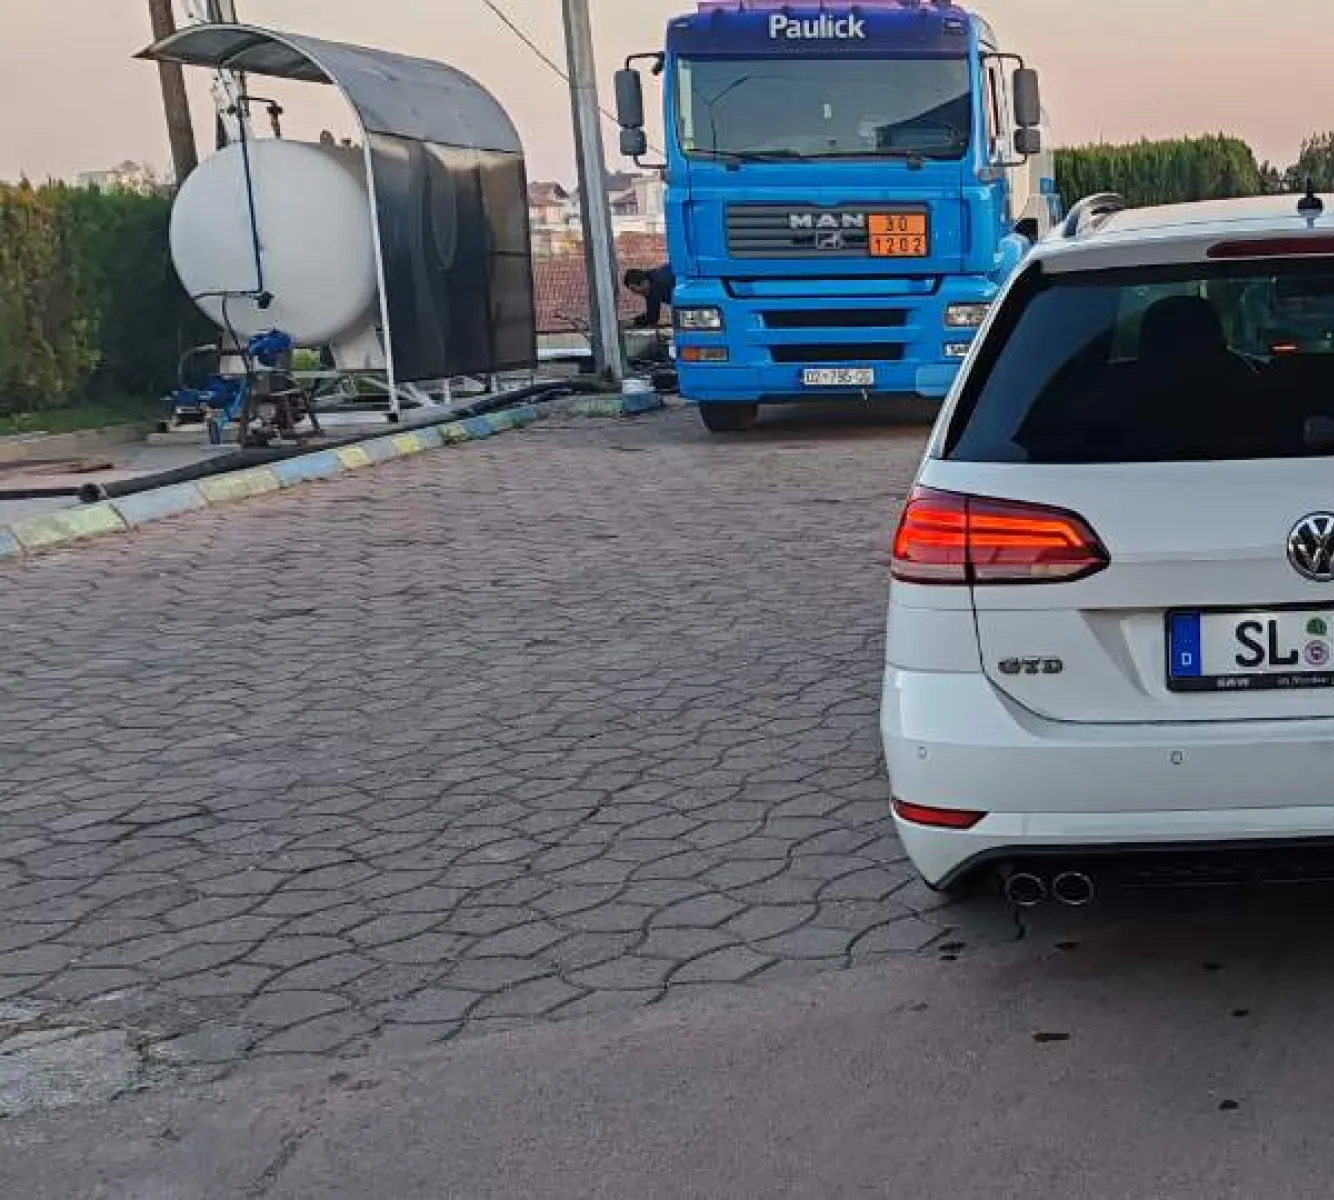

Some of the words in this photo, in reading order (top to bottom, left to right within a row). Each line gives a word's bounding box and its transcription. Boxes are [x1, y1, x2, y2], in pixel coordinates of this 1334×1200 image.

[769, 13, 866, 39] Paulick
[789, 213, 864, 228] MAN
[886, 215, 907, 232] 30
[875, 237, 922, 254] 1202
[1235, 619, 1299, 667] SL
[998, 658, 1063, 674] GTD
